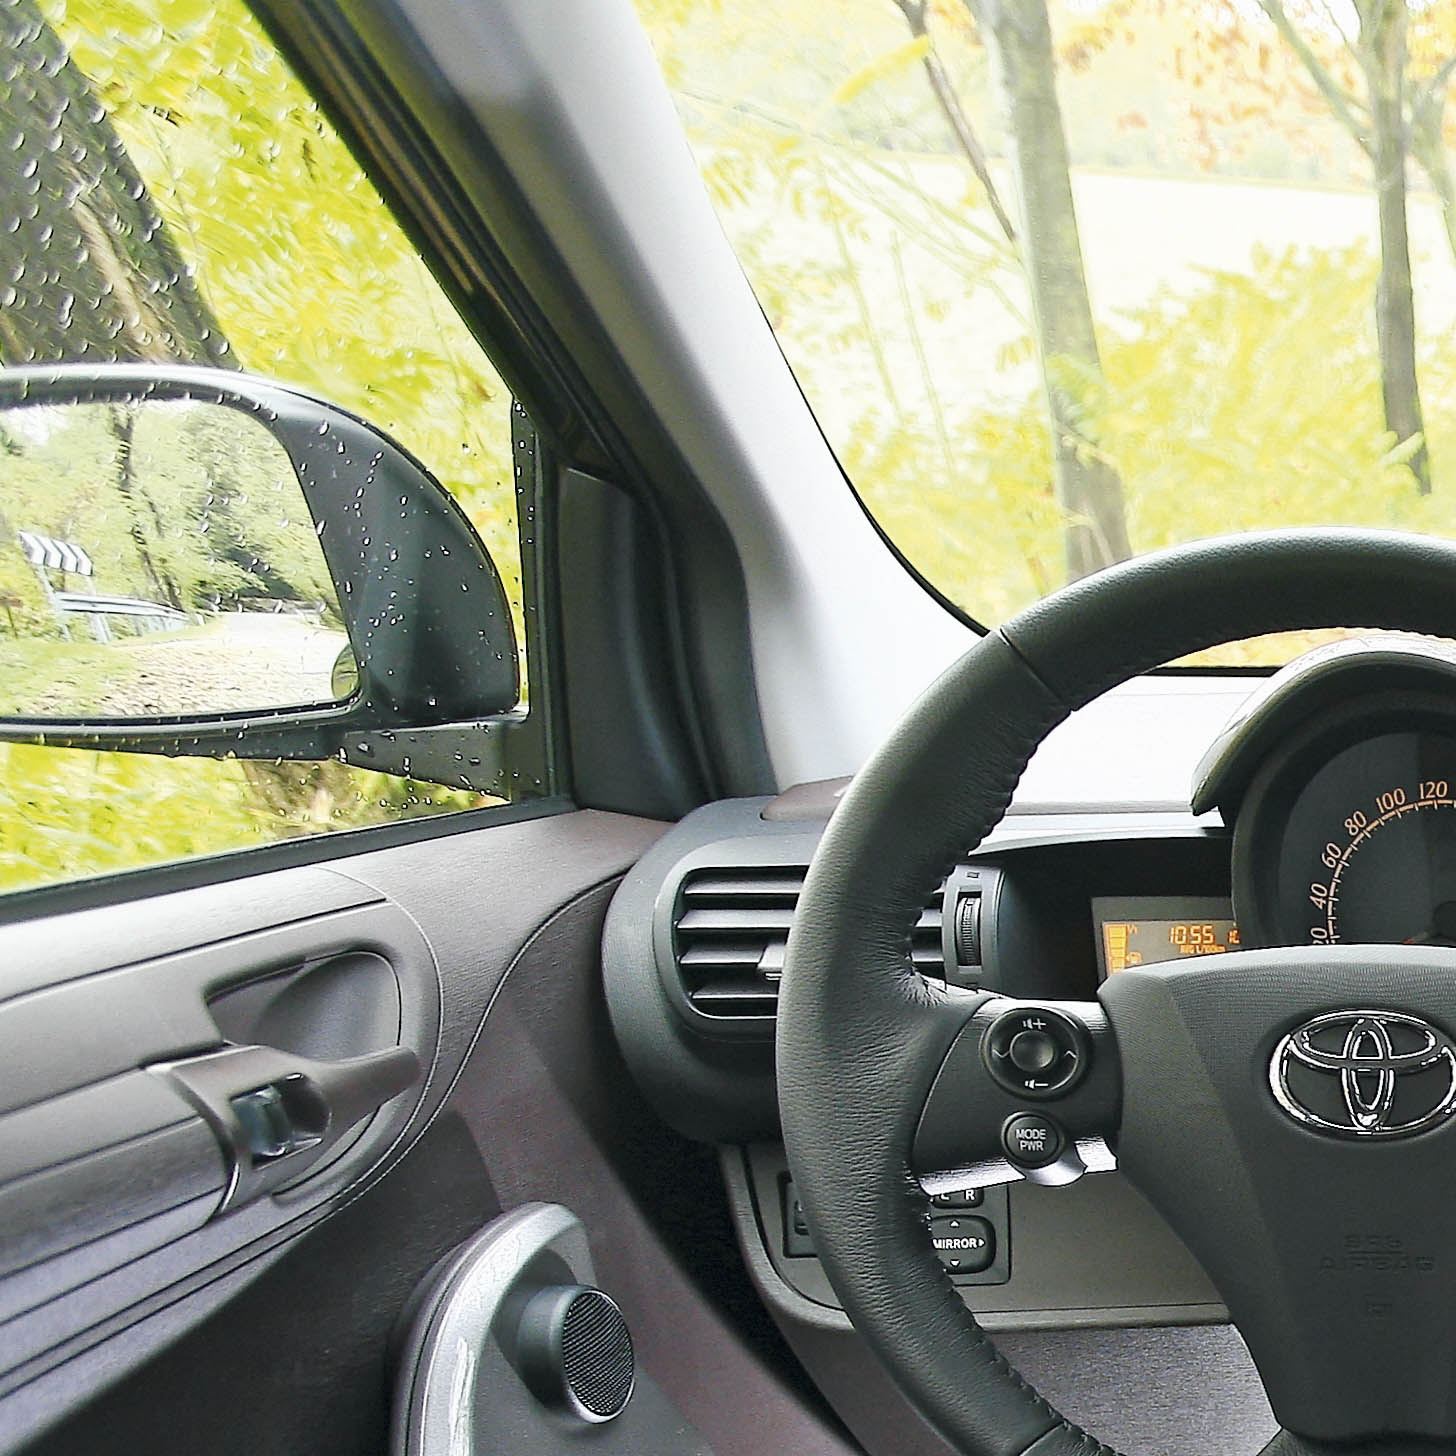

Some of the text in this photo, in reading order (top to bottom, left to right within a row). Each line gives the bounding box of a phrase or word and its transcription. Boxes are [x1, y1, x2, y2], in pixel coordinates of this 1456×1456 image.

[1419, 781, 1448, 800] 120
[1376, 788, 1406, 814] 100
[1344, 811, 1367, 836] 80
[1321, 843, 1342, 868] 60
[1309, 883, 1328, 910] 40
[1016, 1129, 1046, 1140] MODE
[1020, 1140, 1044, 1151] PWR
[965, 1189, 975, 1200] R
[932, 1238, 977, 1249] MIRROR
